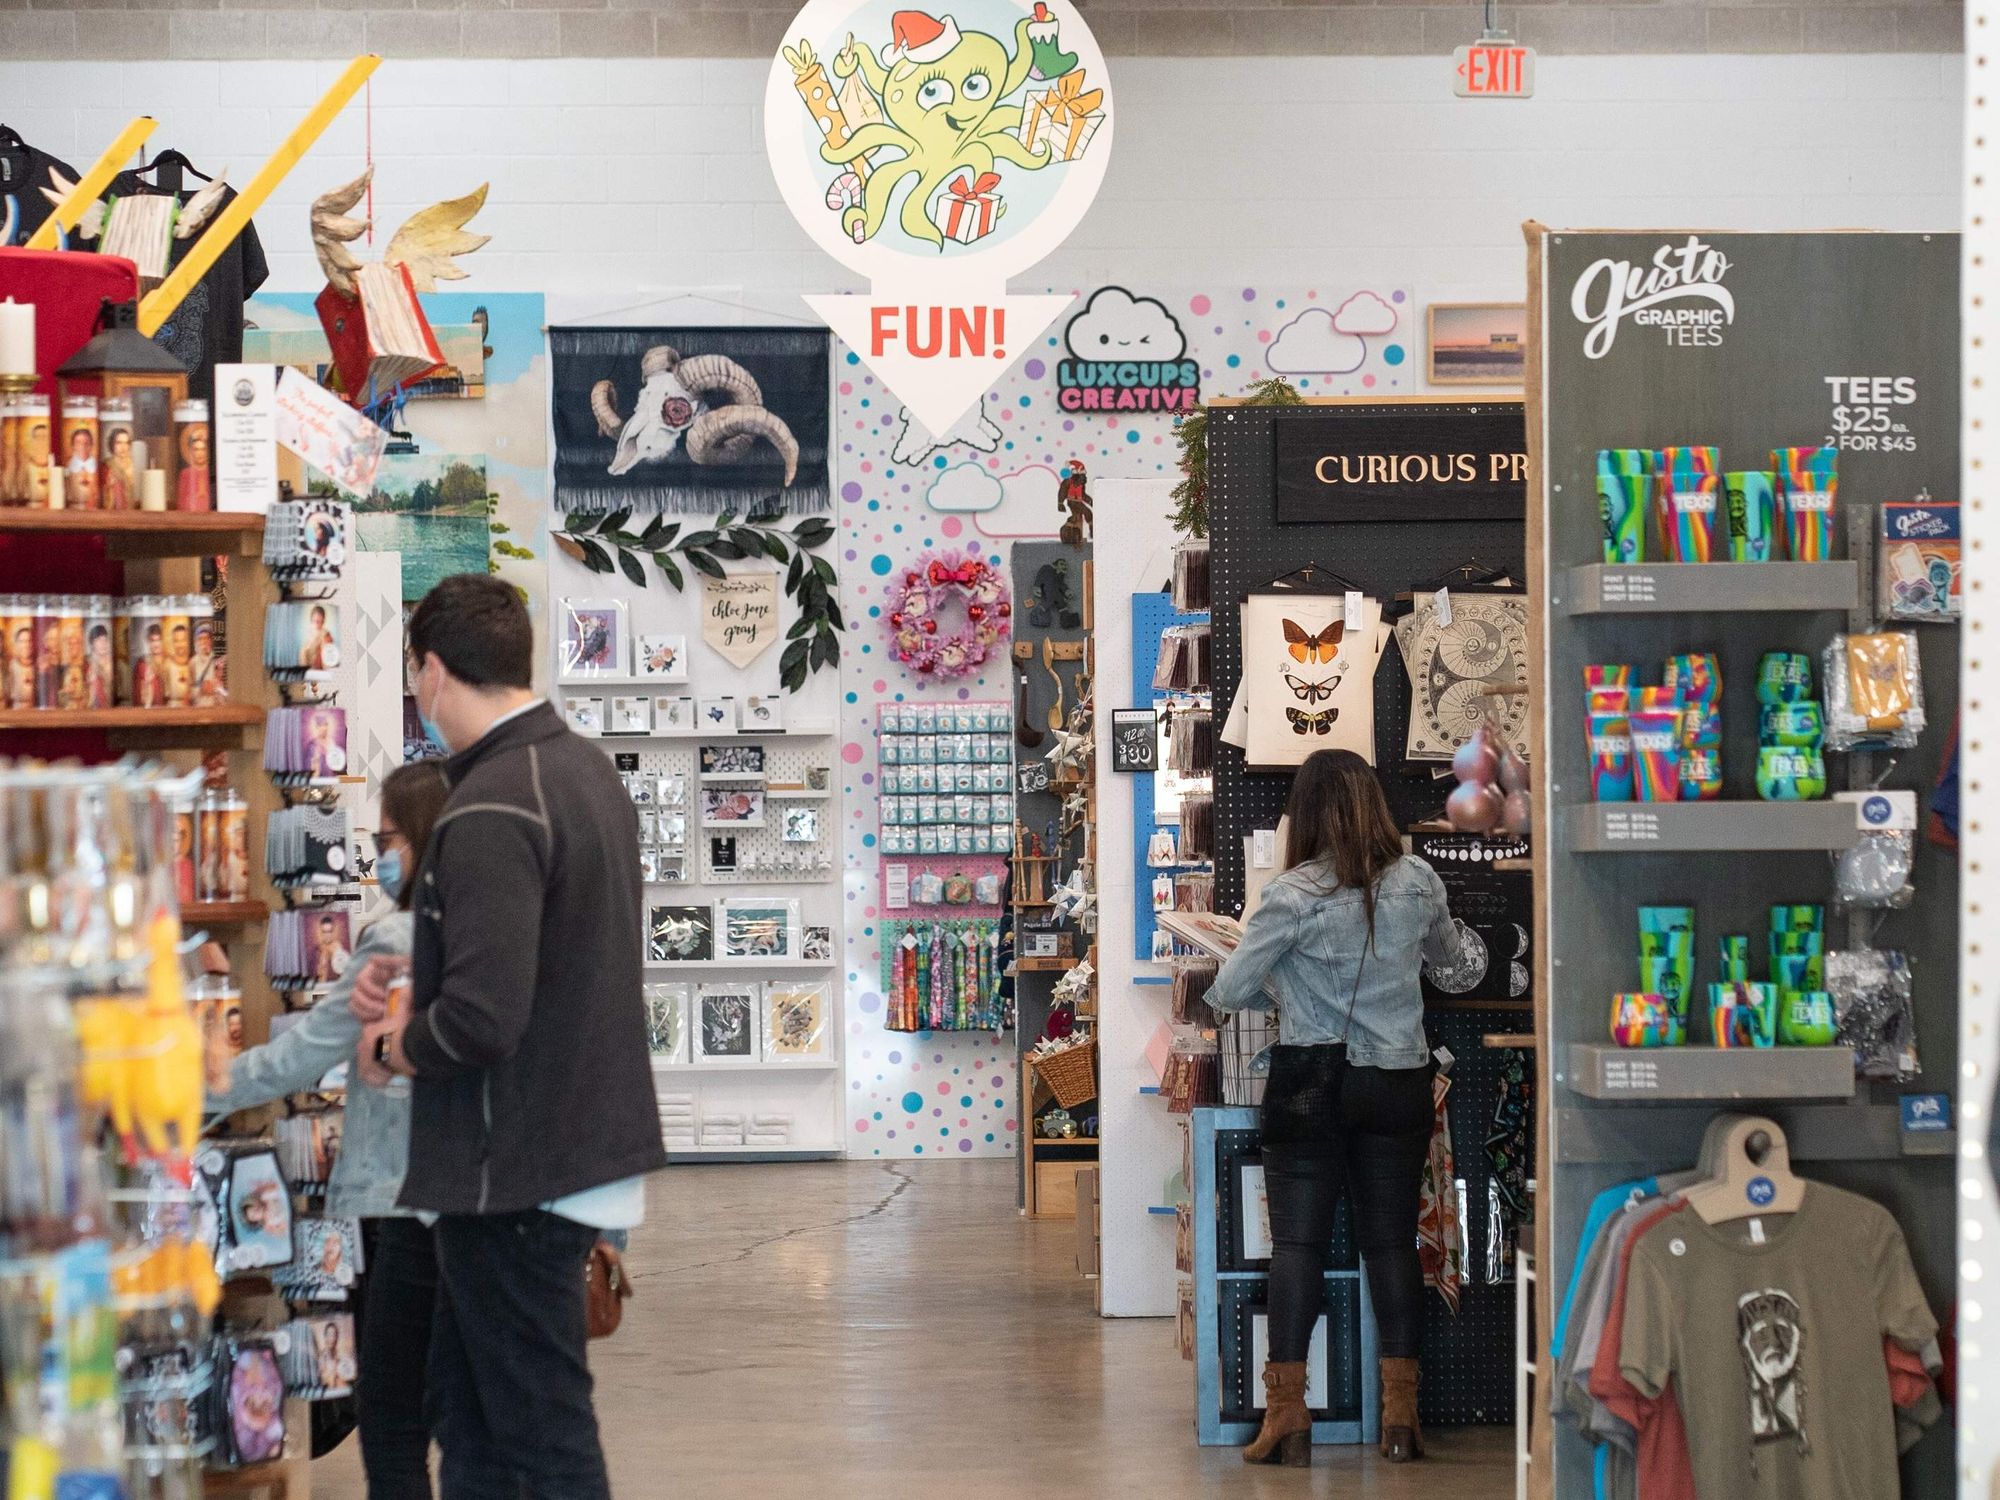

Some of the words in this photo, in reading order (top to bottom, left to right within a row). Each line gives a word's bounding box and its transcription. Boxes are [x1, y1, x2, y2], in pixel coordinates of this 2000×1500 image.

[1468, 48, 1526, 92] EXIT
[1571, 235, 1735, 359] gusto
[1634, 309, 1723, 325] GRAPHIC
[870, 305, 1006, 359] FUN!
[1662, 325, 1723, 346] TEES
[1060, 362, 1197, 387] LUXCUPS
[1061, 387, 1197, 410] CREATIVE
[1824, 376, 1917, 404] TEES
[1832, 405, 1891, 434] $25
[1824, 435, 1836, 448] 2
[1839, 435, 1878, 451] FOR
[1881, 435, 1917, 453] $45
[1315, 454, 1477, 483] CURIOUS
[724, 623, 756, 646] gray
[1119, 744, 1127, 754] 3
[1128, 744, 1152, 765] 30
